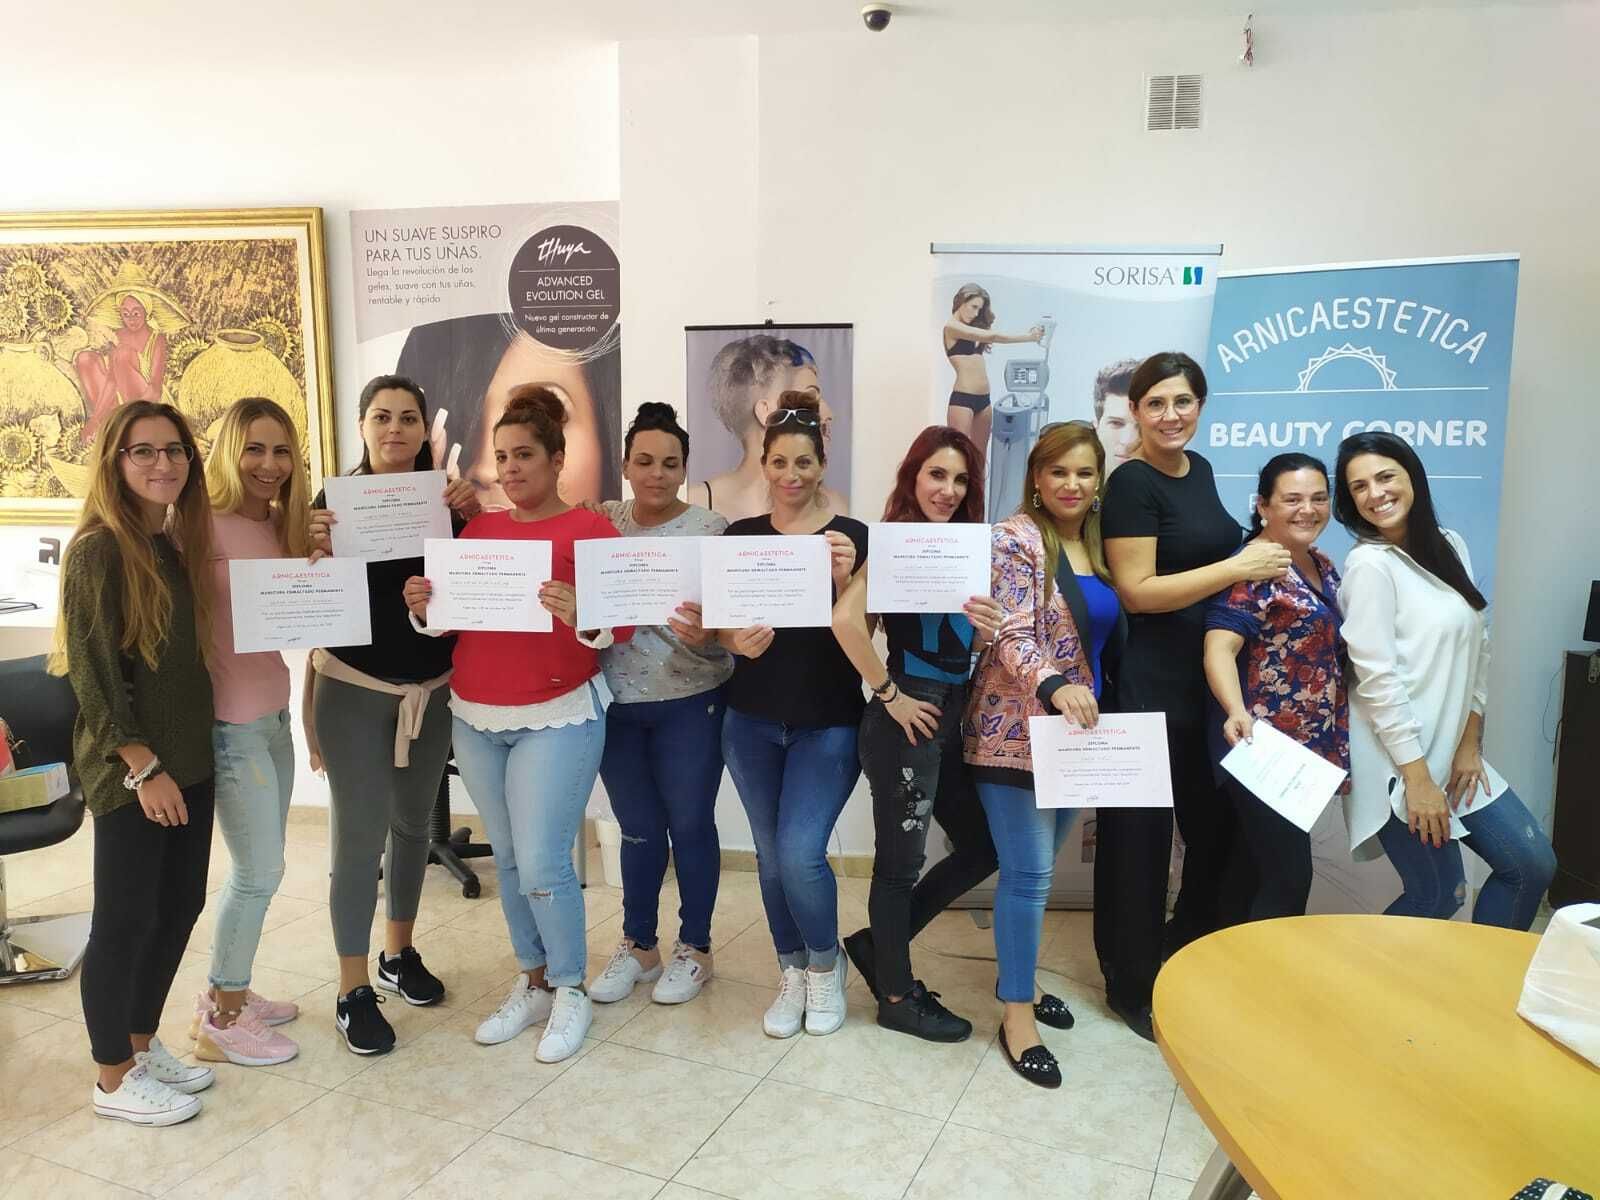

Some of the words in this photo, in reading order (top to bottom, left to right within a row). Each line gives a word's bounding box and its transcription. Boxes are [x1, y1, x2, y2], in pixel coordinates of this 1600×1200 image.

[365, 229, 387, 243] UN
[392, 227, 437, 242] SUAVE
[442, 225, 502, 240] SUSPIRO
[366, 247, 401, 262] PARA
[407, 246, 431, 261] TUS
[436, 242, 482, 260] UÑAS.
[367, 267, 389, 278] Llega
[392, 266, 399, 275] la
[402, 265, 445, 276] revolución
[448, 264, 459, 274] de
[461, 263, 473, 274] los
[1094, 266, 1175, 286] SORISA
[439, 281, 451, 289] tus
[536, 275, 593, 287] ADVANCED
[368, 295, 402, 305] rentable
[526, 290, 583, 301] EVOLUTION
[586, 289, 605, 300] GEL
[524, 313, 547, 322] Nuevo
[549, 312, 560, 323] gel
[561, 312, 597, 321] constructor
[600, 311, 609, 320] de
[1216, 296, 1488, 373] ARNICAESTETICA
[1210, 420, 1332, 447] BEAUTY
